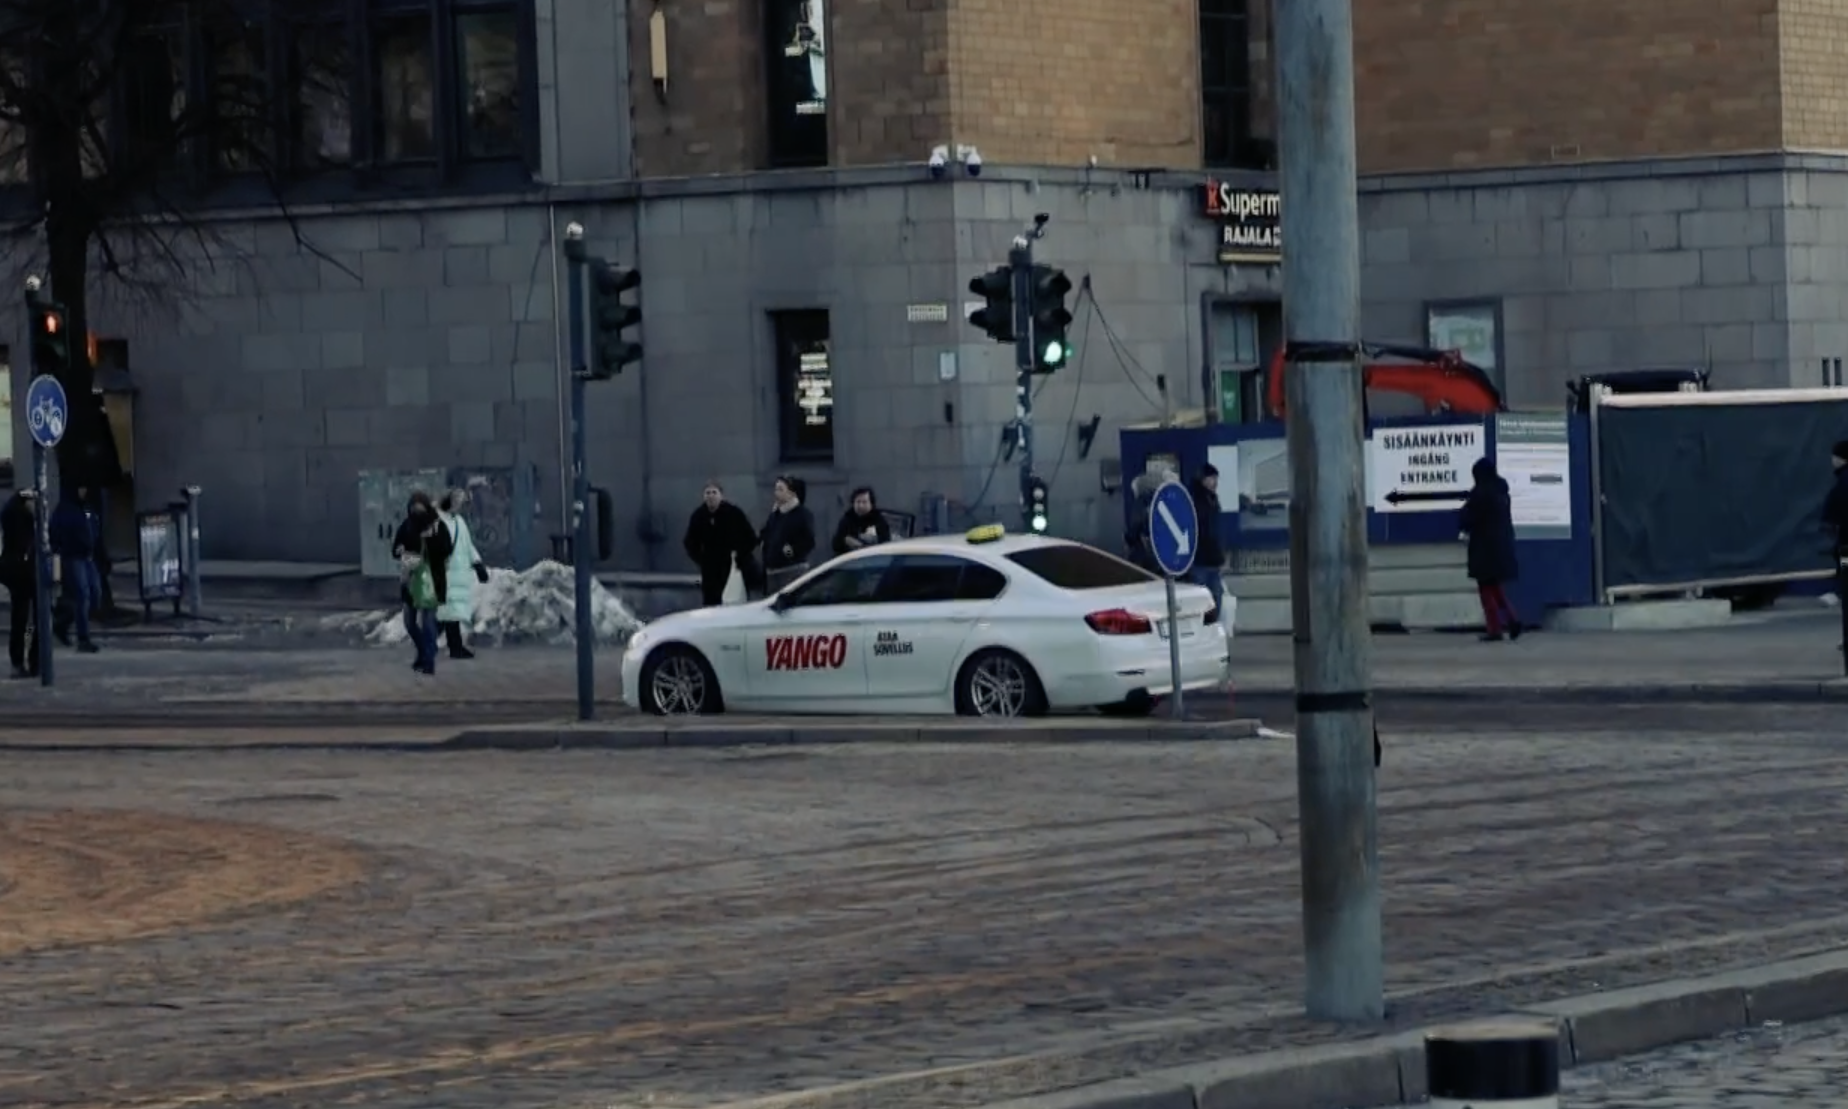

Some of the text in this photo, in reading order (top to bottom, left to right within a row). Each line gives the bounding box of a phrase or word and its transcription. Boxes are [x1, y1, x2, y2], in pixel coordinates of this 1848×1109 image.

[1383, 431, 1475, 450] SISÄÄNKÄYNTI
[1408, 451, 1450, 466] INGÅNG
[1400, 469, 1458, 484] ENTRANCE
[765, 633, 847, 671] YANGO
